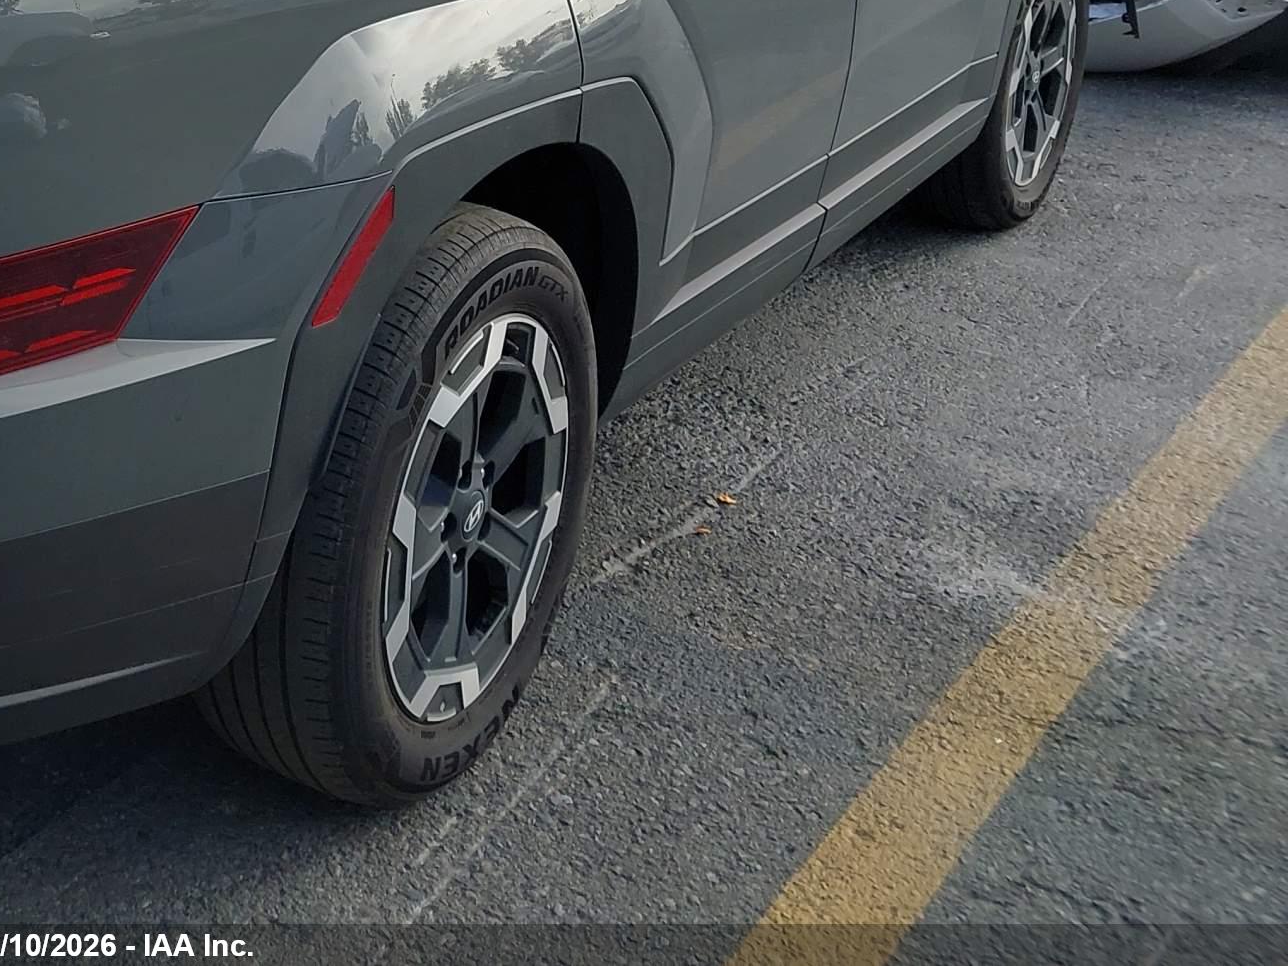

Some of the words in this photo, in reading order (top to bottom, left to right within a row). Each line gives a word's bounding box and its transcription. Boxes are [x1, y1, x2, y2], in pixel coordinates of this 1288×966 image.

[444, 266, 540, 360] ROADIAN
[539, 275, 569, 303] GTX
[420, 684, 520, 782] NEXEN
